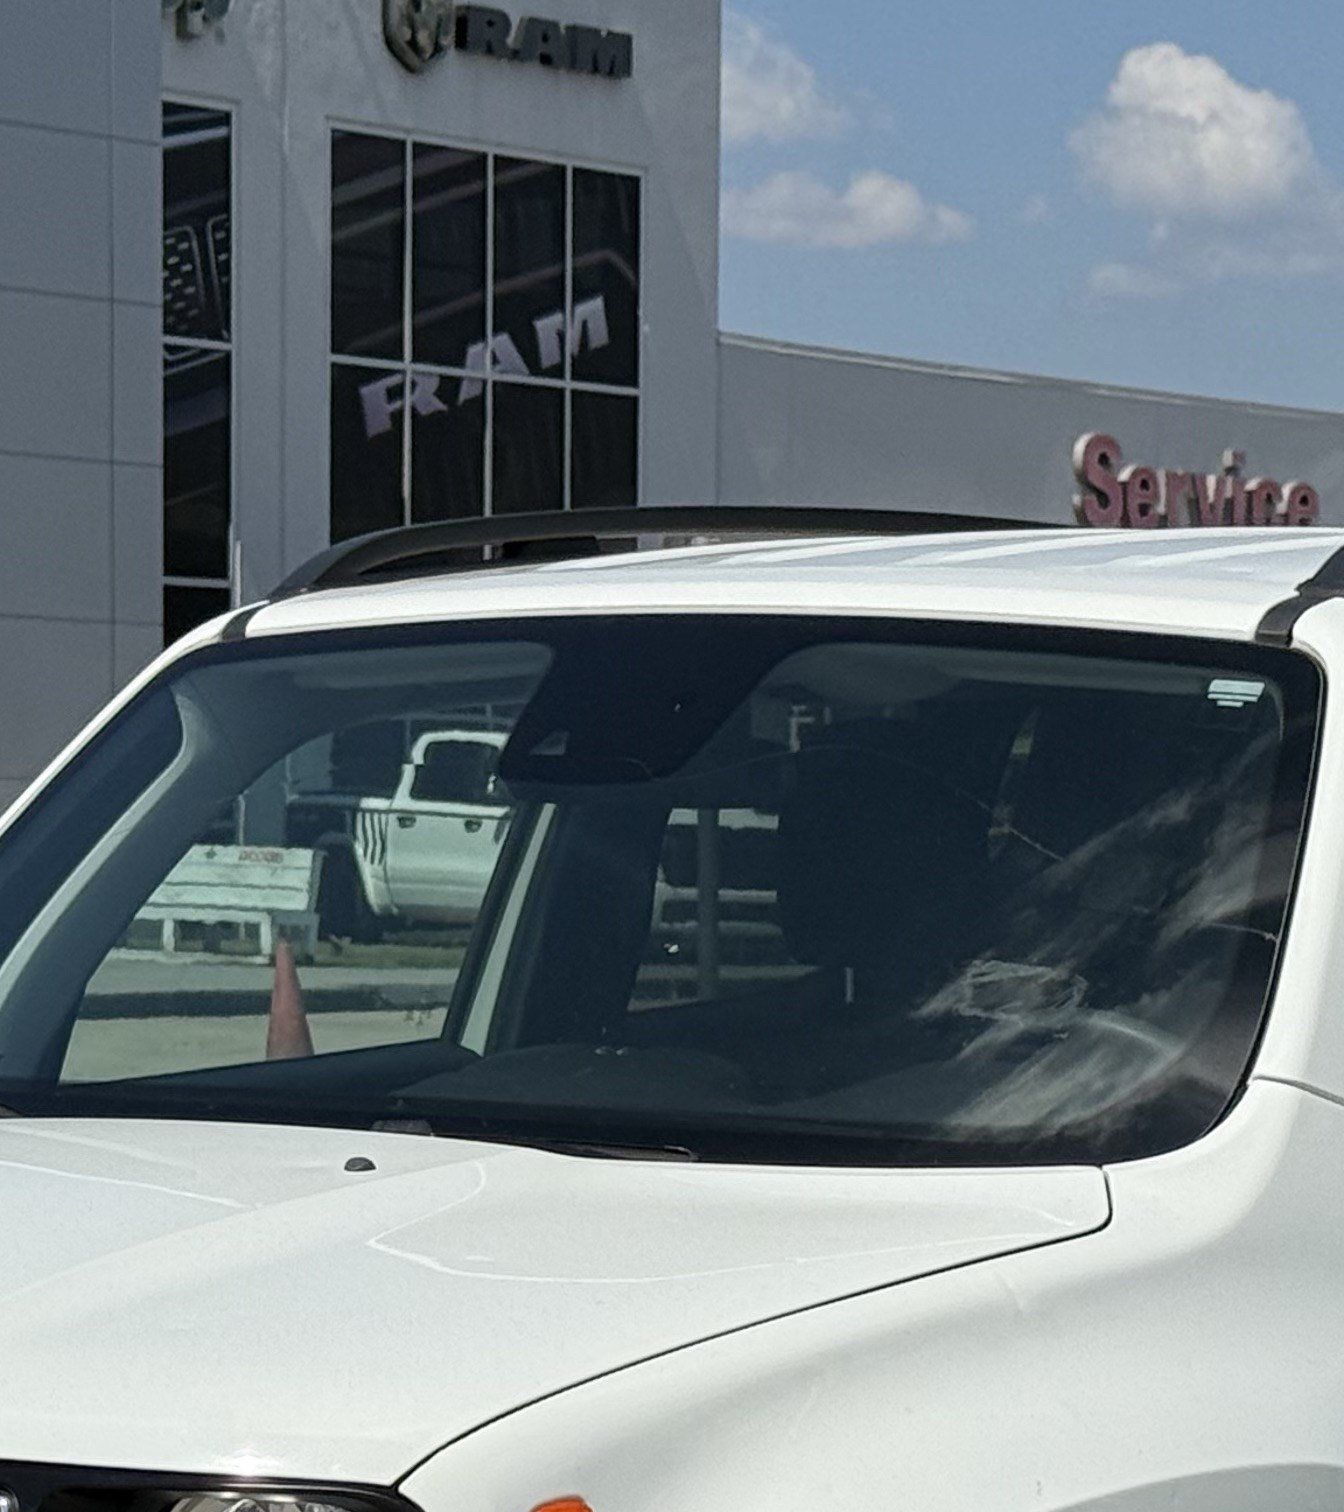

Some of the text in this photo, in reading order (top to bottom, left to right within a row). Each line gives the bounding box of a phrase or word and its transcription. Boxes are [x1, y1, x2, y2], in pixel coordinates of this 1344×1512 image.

[456, 4, 633, 79] RAM
[360, 295, 610, 440] RAM
[1071, 430, 1320, 527] Service
